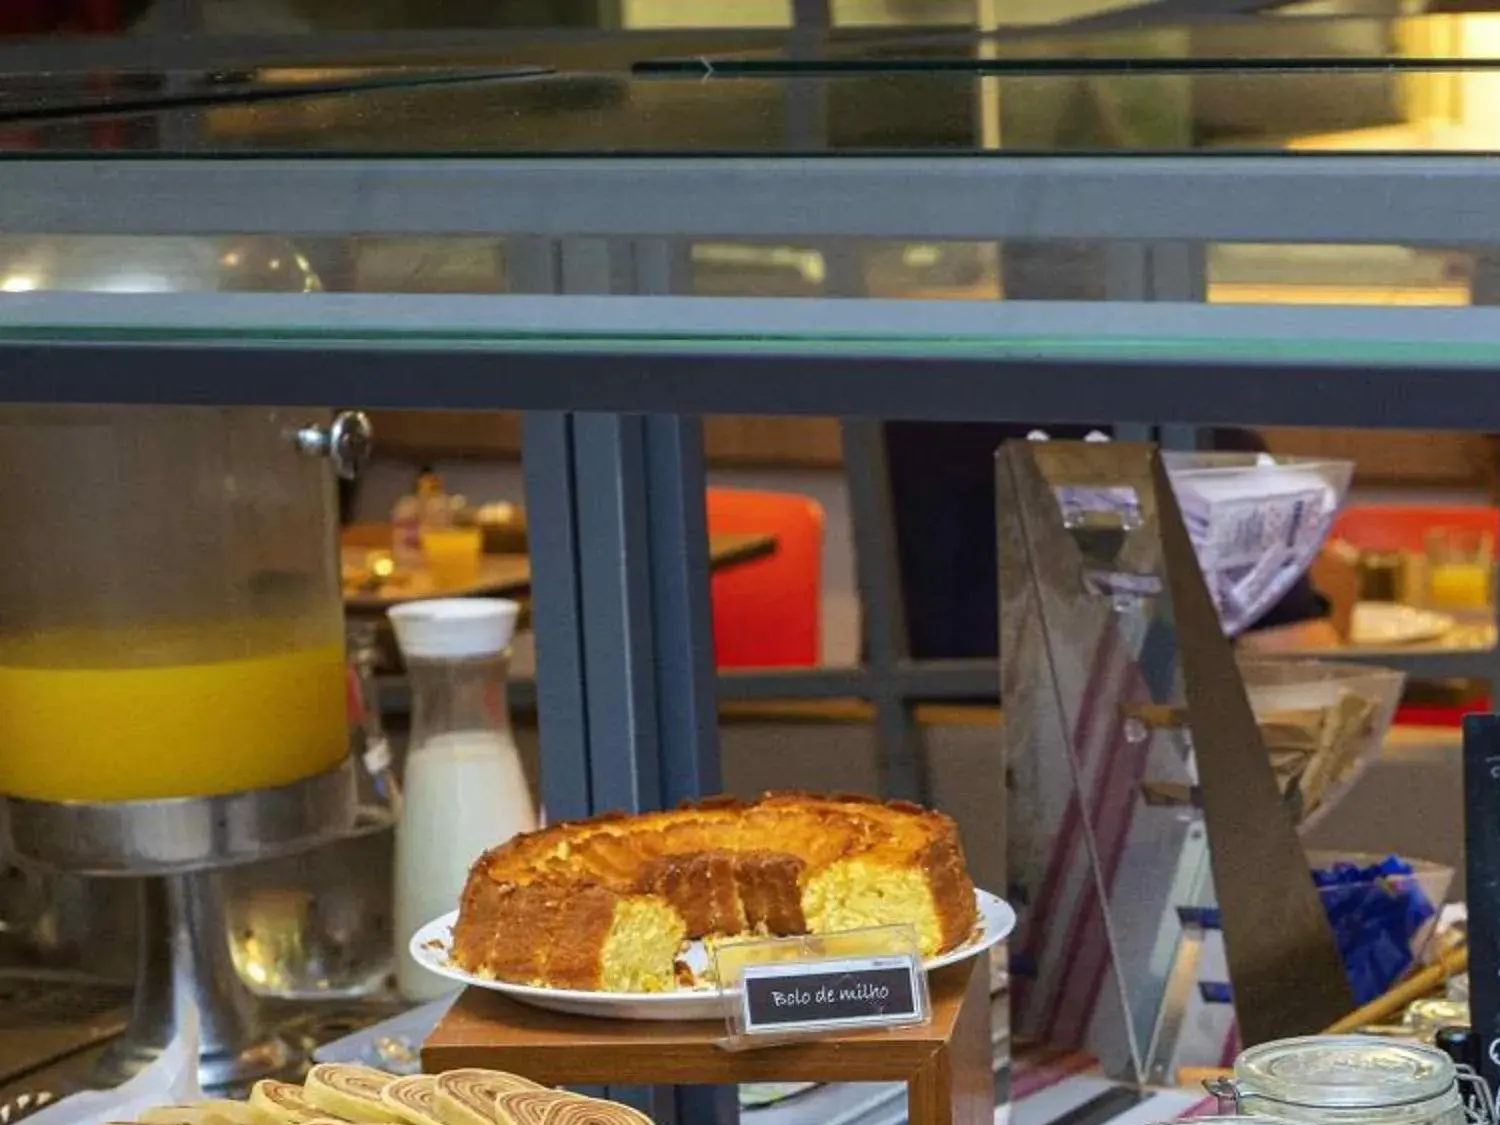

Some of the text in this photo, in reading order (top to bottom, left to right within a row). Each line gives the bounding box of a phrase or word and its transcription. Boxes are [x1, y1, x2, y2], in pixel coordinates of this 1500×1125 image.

[770, 983, 889, 1007] Bolo de milho
